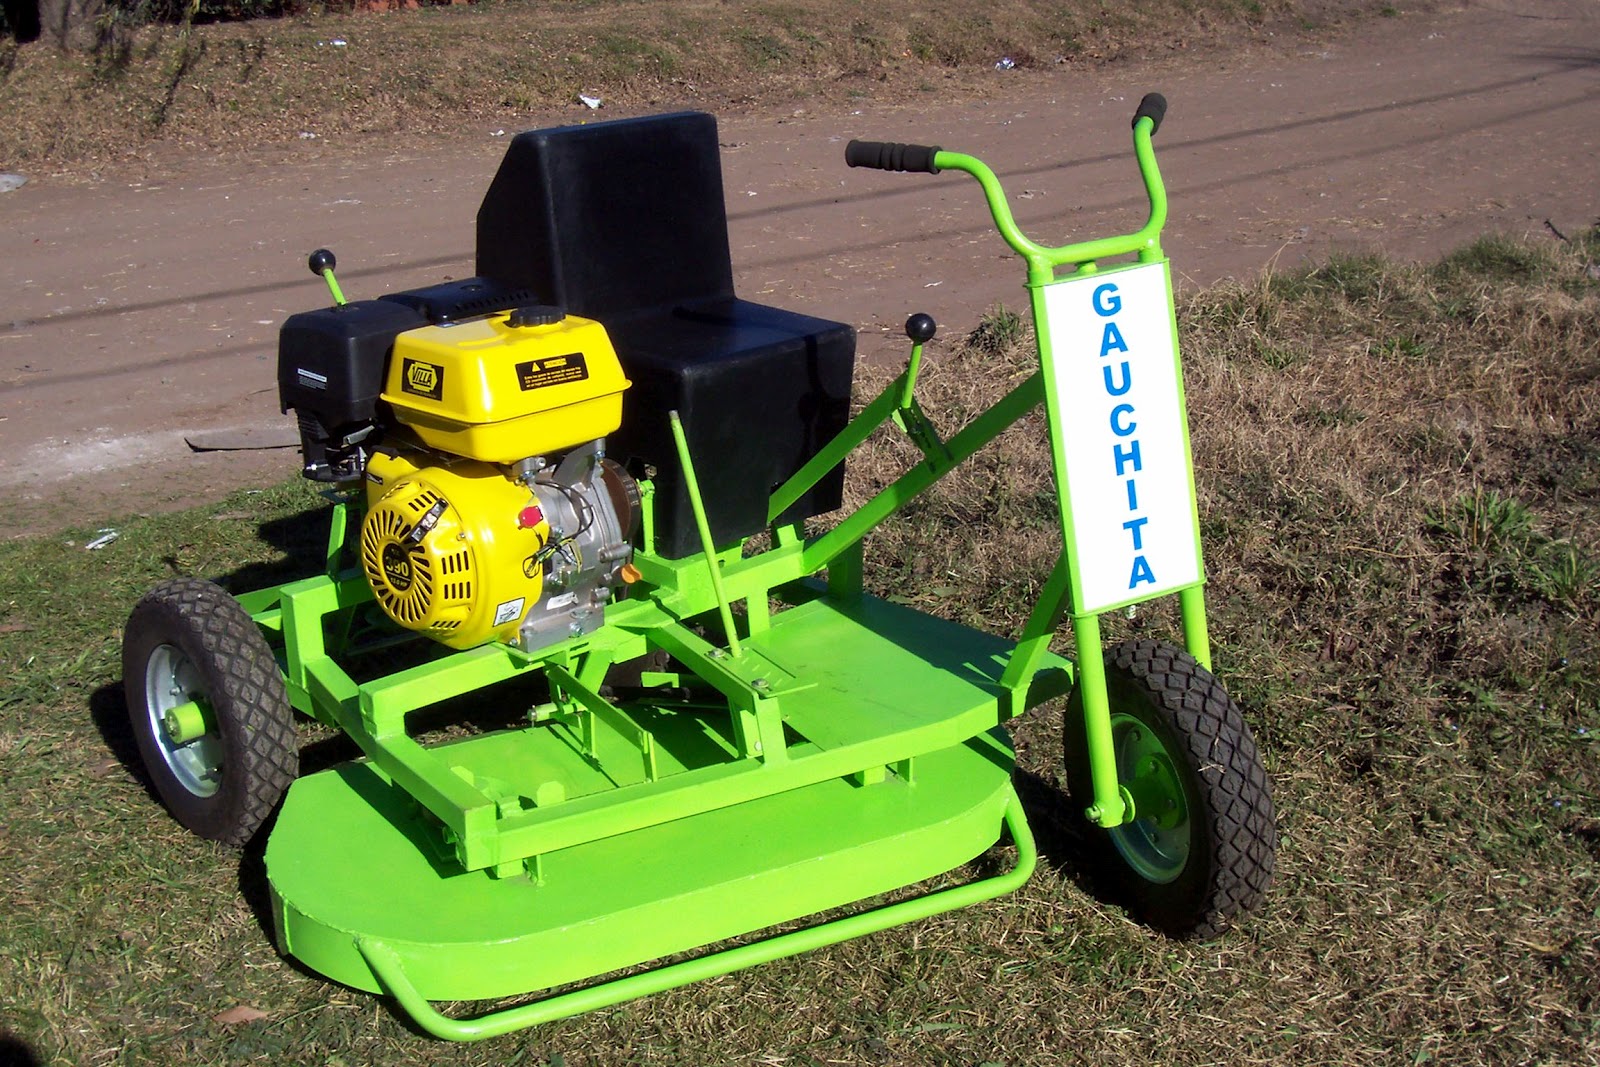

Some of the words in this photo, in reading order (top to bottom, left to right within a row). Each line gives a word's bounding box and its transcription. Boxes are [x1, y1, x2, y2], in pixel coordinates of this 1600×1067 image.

[411, 365, 434, 387] VILLA
[1092, 283, 1156, 590] GAUCHITA
[385, 555, 409, 577] 390
